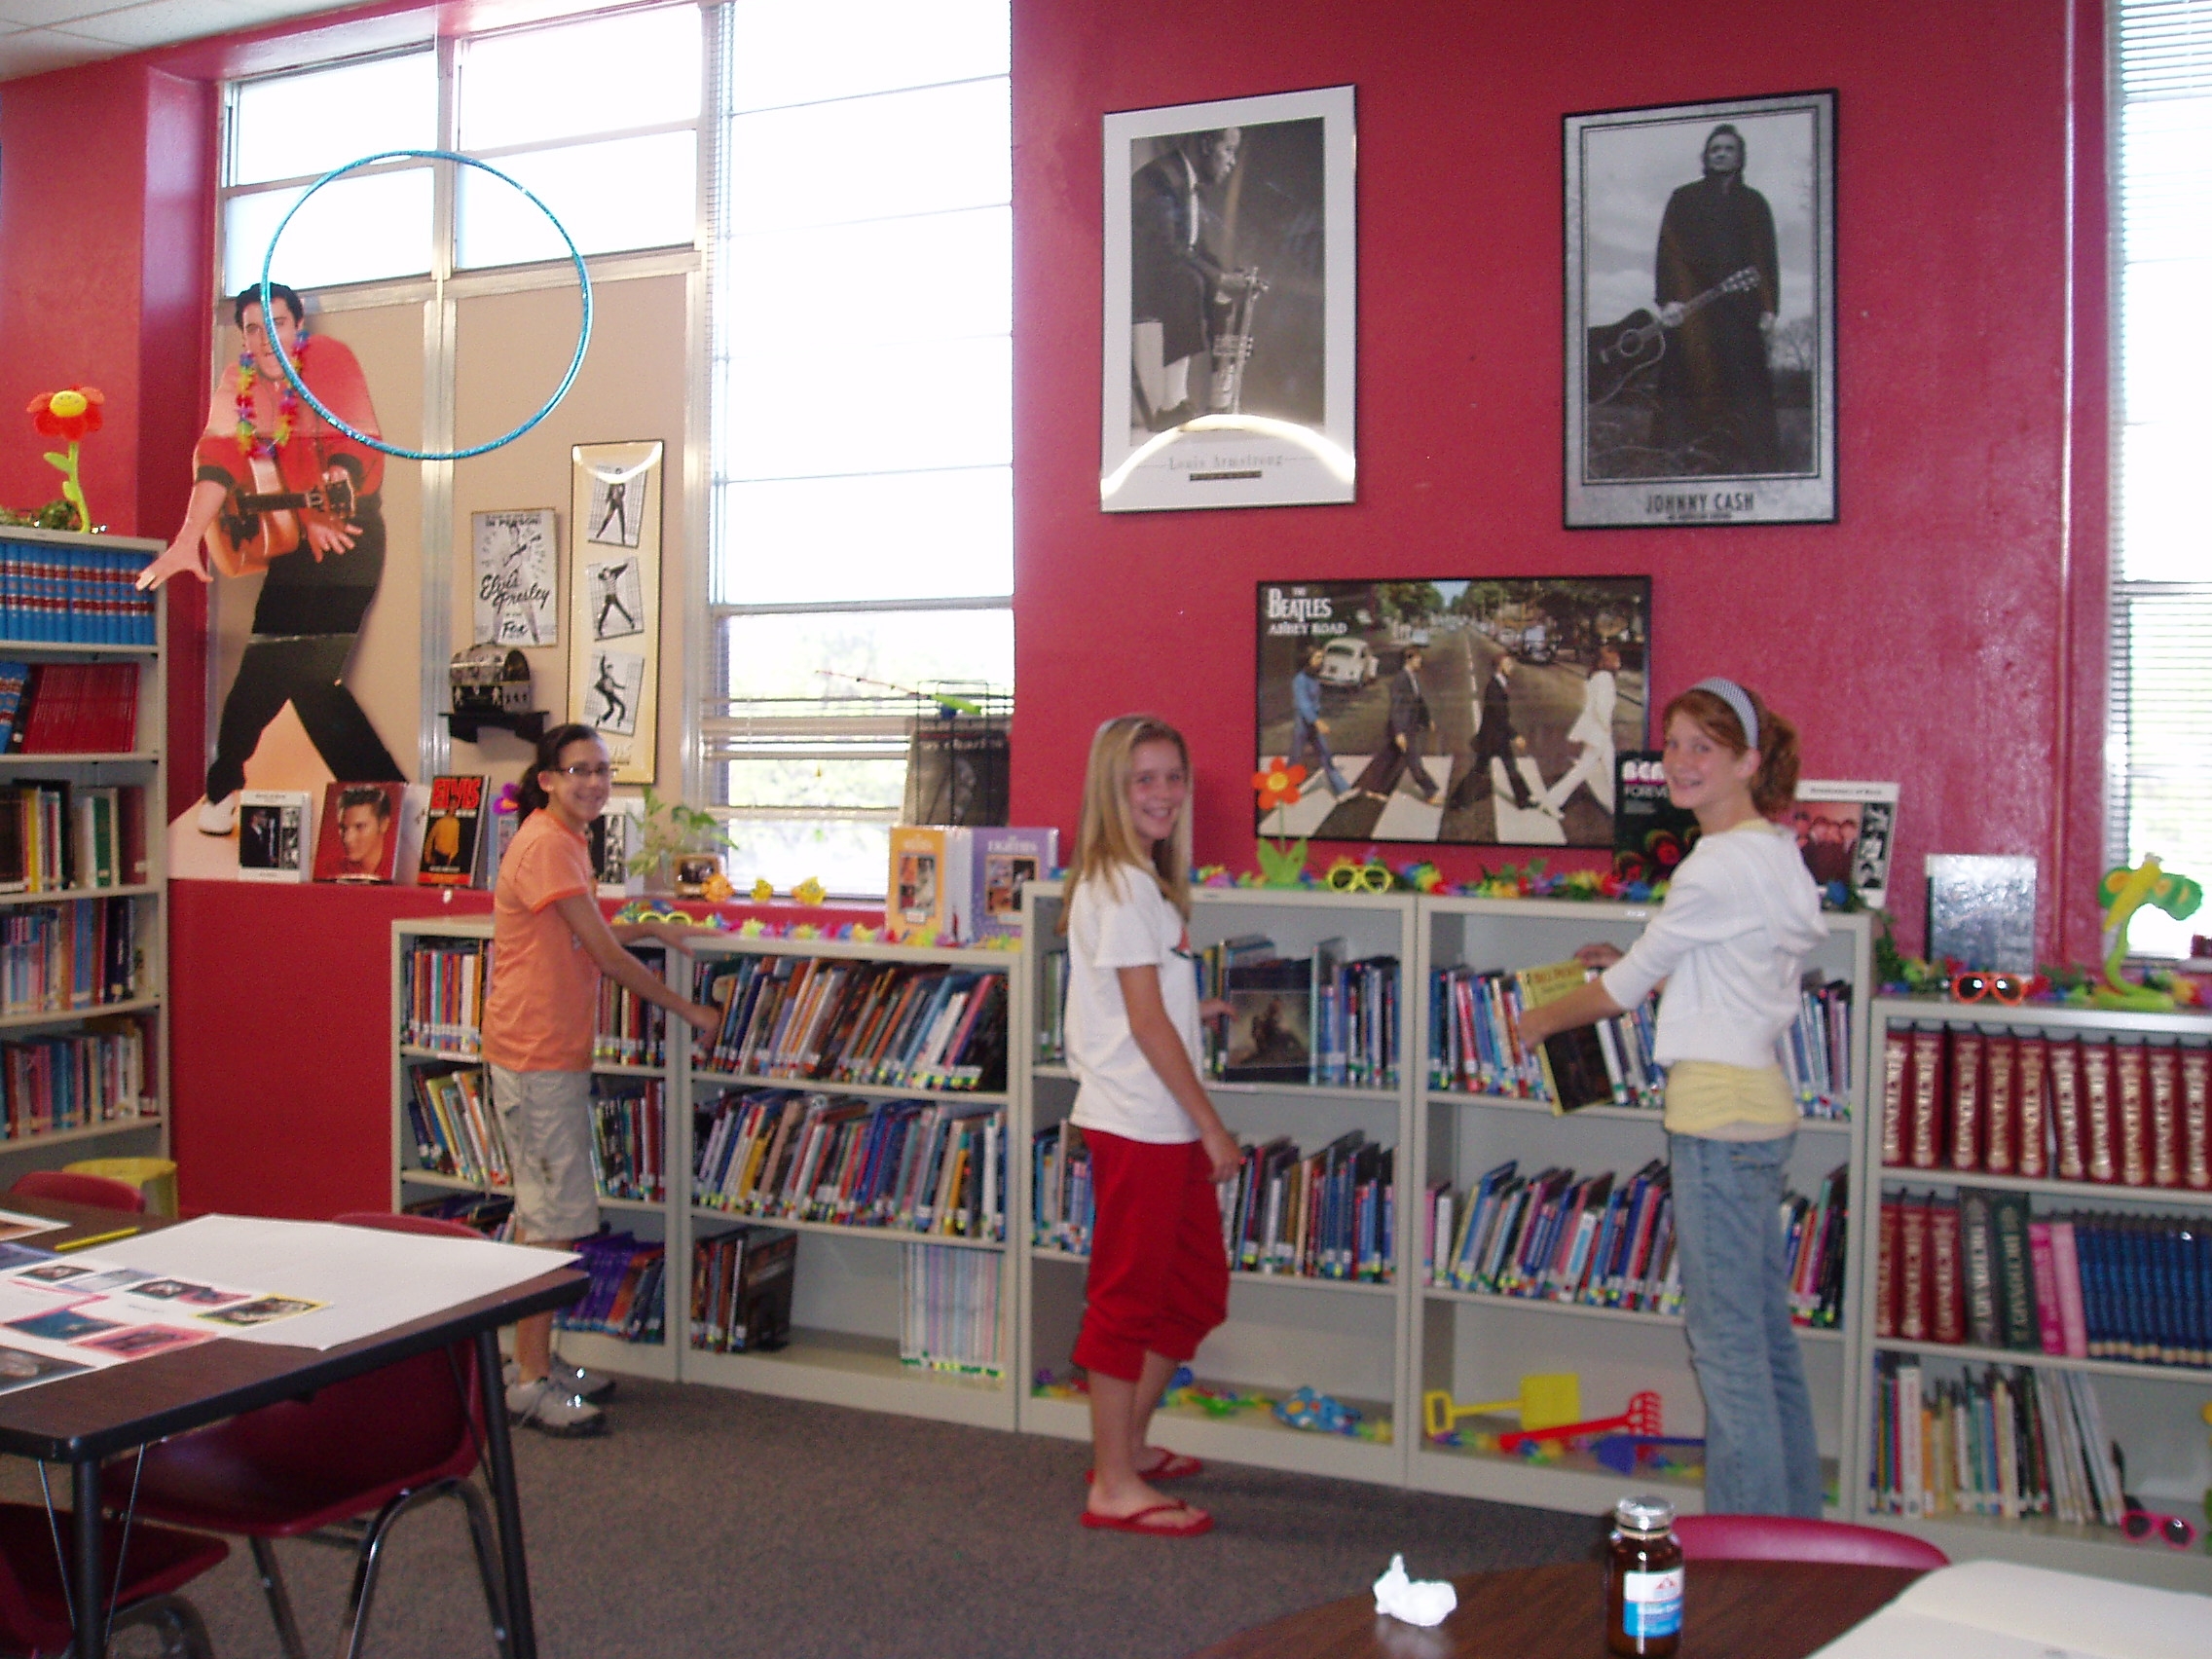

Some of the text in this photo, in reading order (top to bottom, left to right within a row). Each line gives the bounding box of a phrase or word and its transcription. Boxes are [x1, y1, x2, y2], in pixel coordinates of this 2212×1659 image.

[1169, 456, 1205, 469] Louis
[1645, 492, 1754, 514] JOHNNY CASH
[480, 569, 518, 600] Elvis
[492, 582, 550, 614] Presley
[1268, 587, 1332, 622] BEATLES
[1311, 622, 1347, 635] ROAD
[430, 777, 483, 809] ELVIS
